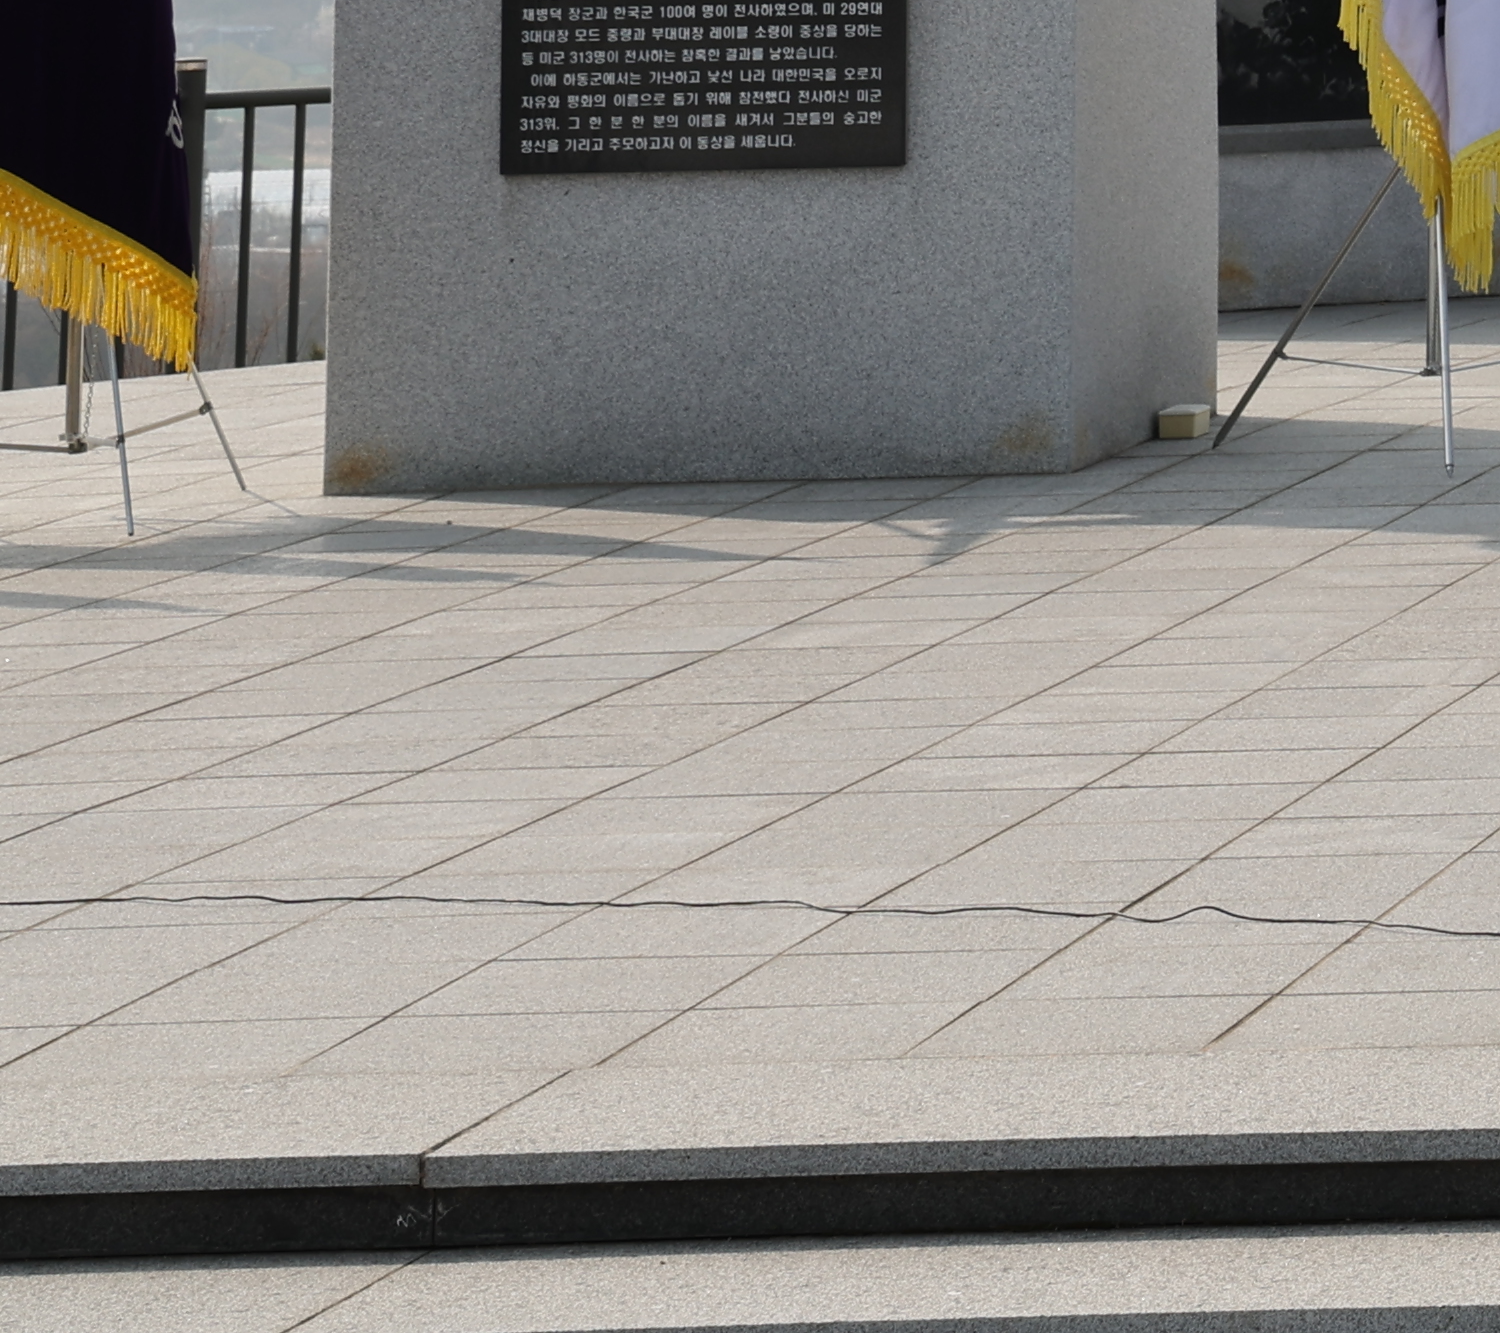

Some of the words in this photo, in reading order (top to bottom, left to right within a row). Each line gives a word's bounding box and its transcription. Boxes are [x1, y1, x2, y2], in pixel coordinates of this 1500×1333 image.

[521, 51, 534, 66] 등
[539, 51, 565, 65] 미군
[569, 50, 619, 65] 313명이
[624, 49, 676, 64] 전사하는
[520, 138, 559, 154] 정신을
[565, 137, 604, 152] 기리고
[609, 136, 675, 151] 추모하고자
[679, 136, 692, 150] 이
[697, 134, 736, 150] 동상을
